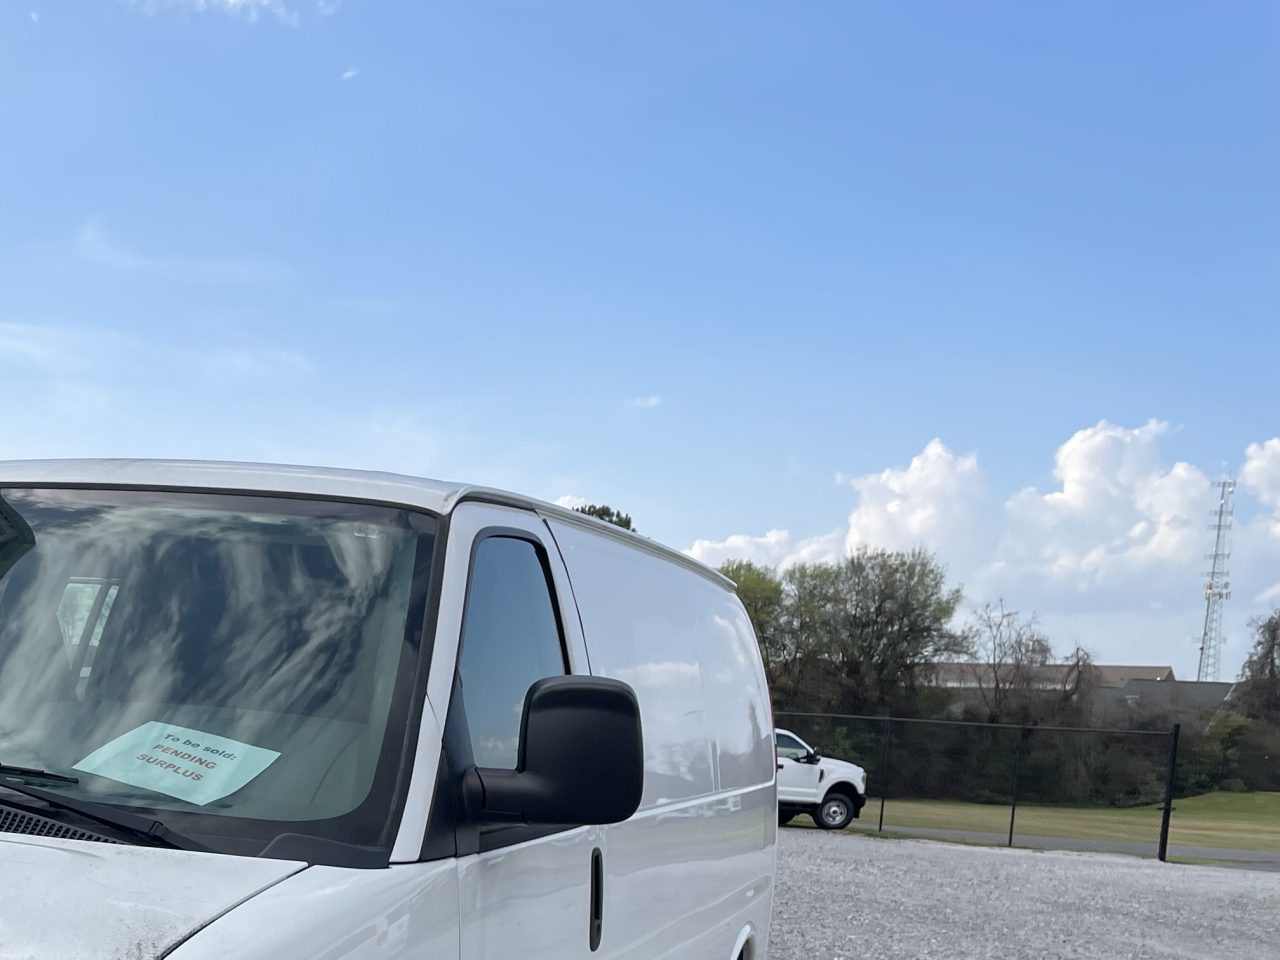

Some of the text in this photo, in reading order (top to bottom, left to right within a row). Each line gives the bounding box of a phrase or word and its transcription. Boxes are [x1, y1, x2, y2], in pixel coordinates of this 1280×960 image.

[152, 744, 218, 769] PENDING
[163, 733, 238, 760] To be sold:
[136, 753, 204, 781] SURPLUS
